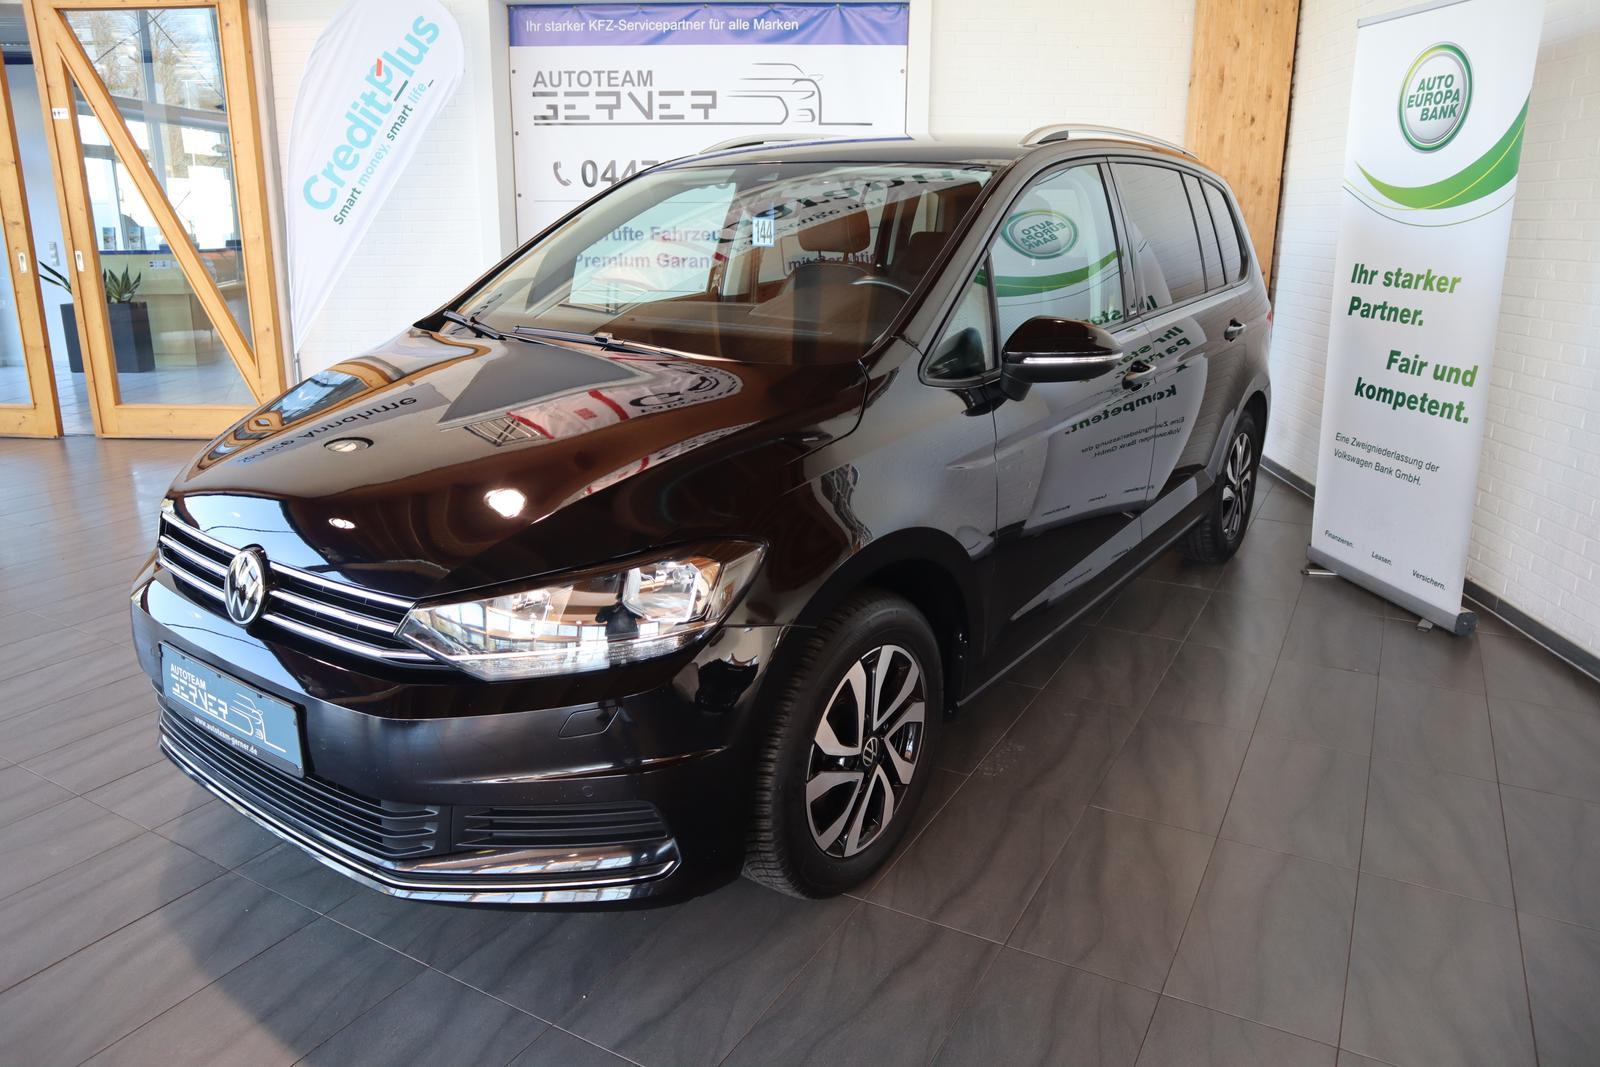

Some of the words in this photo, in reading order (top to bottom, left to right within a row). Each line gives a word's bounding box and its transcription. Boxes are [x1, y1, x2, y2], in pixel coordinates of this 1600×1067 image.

[526, 20, 541, 32] Ihr
[544, 20, 585, 32] starker
[589, 19, 705, 33] KFZ-Servicepartner
[709, 18, 725, 31] für
[728, 18, 750, 31] alle
[753, 18, 799, 31] Marken
[532, 70, 654, 88] AUTOTEAM
[1417, 74, 1454, 92] AUTO
[303, 15, 440, 210] CreditPlus
[1407, 88, 1460, 109] EUROPA
[1420, 103, 1459, 122] BANK
[333, 187, 362, 225] Smart
[359, 144, 391, 187] money,
[386, 103, 414, 142] smart
[755, 221, 773, 244] 144
[1351, 263, 1378, 285] Ihr
[1383, 267, 1461, 293] starker
[1348, 296, 1424, 326] Partner.
[1386, 350, 1428, 376] Fair
[1433, 365, 1478, 387] und
[1354, 377, 1469, 424] kompetent.
[1334, 448, 1373, 468] Volkswagen
[1374, 462, 1393, 476] Bank
[1395, 469, 1421, 486] GmbH.
[1336, 432, 1349, 444] Eine
[1351, 437, 1423, 469] Zweigniederlassung
[1425, 462, 1440, 473] der
[170, 663, 206, 690] AUTOTEAM
